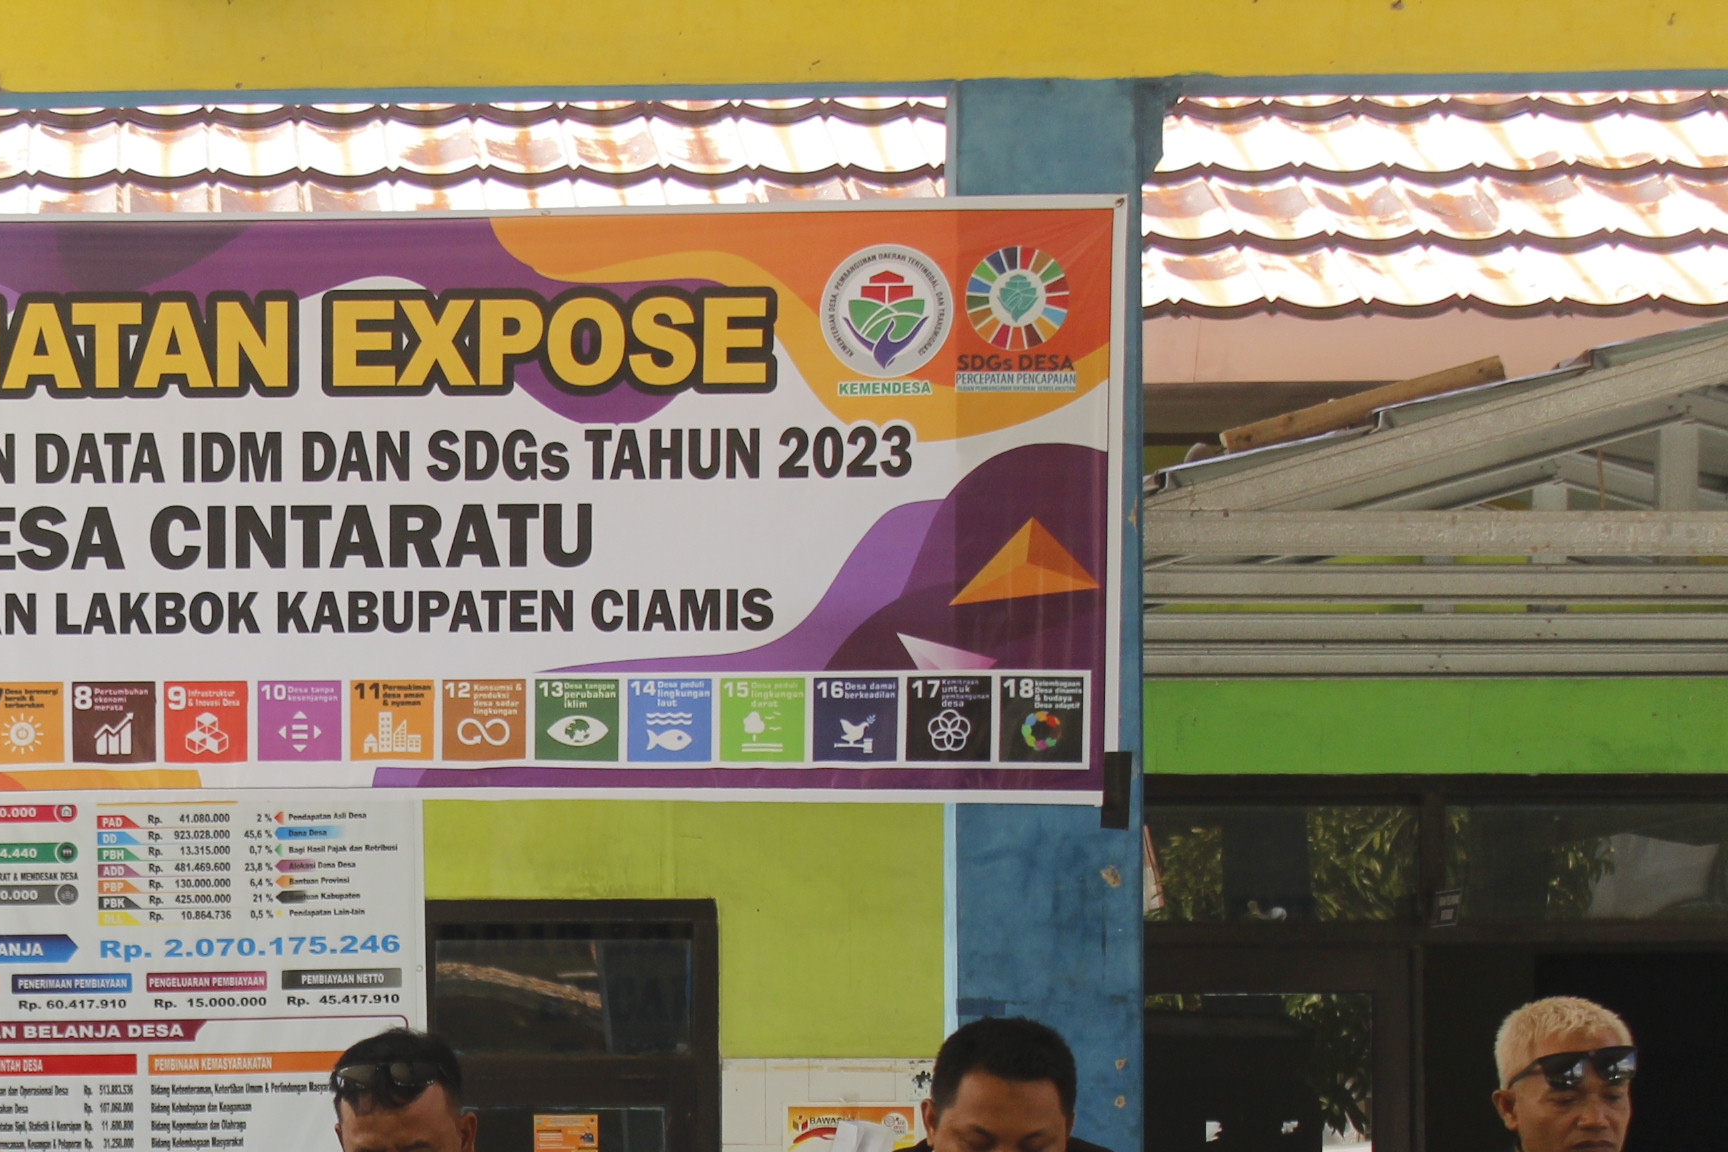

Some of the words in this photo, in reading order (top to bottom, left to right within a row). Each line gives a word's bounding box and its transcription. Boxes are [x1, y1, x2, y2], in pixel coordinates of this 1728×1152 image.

[328, 293, 769, 390] EXPOSE
[957, 354, 1012, 371] SDGs
[1019, 354, 1074, 371] DESA
[956, 373, 1014, 384] PERCEPATAN
[1016, 372, 1076, 384] PENCAPAIAN
[839, 381, 931, 395] KEMENDESA
[36, 432, 165, 485] DATA
[182, 431, 282, 484] IDM
[302, 430, 410, 483] DAN
[426, 429, 570, 482] SDGs
[584, 427, 761, 480] TAHUN
[778, 425, 913, 478] 2023
[149, 503, 595, 570] CINTARATU
[55, 592, 261, 635] LAKBOK
[277, 590, 574, 634] KABUPATEN
[591, 588, 774, 632] CIAMIS
[311, 686, 334, 694] tanpa
[473, 684, 513, 692] Konsumsi
[539, 681, 564, 698] 13
[630, 680, 656, 697] 14
[680, 681, 704, 689] peduli
[723, 681, 750, 698] 15
[817, 681, 844, 698] 16
[845, 682, 867, 690] Desa
[869, 682, 896, 690] damai
[912, 679, 940, 698] 17
[942, 685, 970, 693] untuk
[1003, 679, 1034, 698] 18
[1035, 680, 1081, 688] kelembagaan
[94, 688, 148, 696] Pertumbuhan
[261, 685, 286, 700] 10
[354, 683, 381, 699] 11
[382, 691, 402, 699] desa
[444, 683, 471, 698] 12
[473, 692, 509, 700] produksi
[564, 689, 616, 699] perubahan
[657, 689, 710, 699] lingkungan
[845, 691, 896, 699] berkeadilan
[74, 686, 93, 710] 8
[168, 686, 186, 710] 9
[288, 694, 338, 703] kesenjangan
[391, 700, 421, 708] nyaman
[564, 699, 587, 708] iklim
[657, 699, 677, 708] laut
[942, 699, 964, 708] desa
[1044, 694, 1072, 703] budaya
[473, 707, 517, 716] lingkungan
[1055, 702, 1080, 710] adaptif
[102, 817, 122, 828] PAD
[148, 815, 162, 825] Rp.
[180, 813, 230, 823] 41.080.000
[99, 940, 152, 962] Rp.
[164, 934, 401, 958] 2.070.175.246
[18, 979, 72, 989] PENERIMAAN
[74, 978, 127, 988] PEMBIAYAAN
[149, 978, 210, 987] PENGELUARAN
[212, 977, 265, 987] PEMBIAYAAN
[301, 974, 355, 984] PEMBIAYAAN
[357, 974, 384, 984] NETTO
[18, 1000, 42, 1011] Rp.
[47, 999, 127, 1010] 60.417.910
[154, 999, 177, 1010] Rp.
[187, 997, 267, 1008] 15.000.000
[287, 996, 310, 1007] Rp.
[319, 994, 400, 1005] 45.417.910
[23, 1024, 121, 1039] BELANJA
[128, 1023, 184, 1038] DESA
